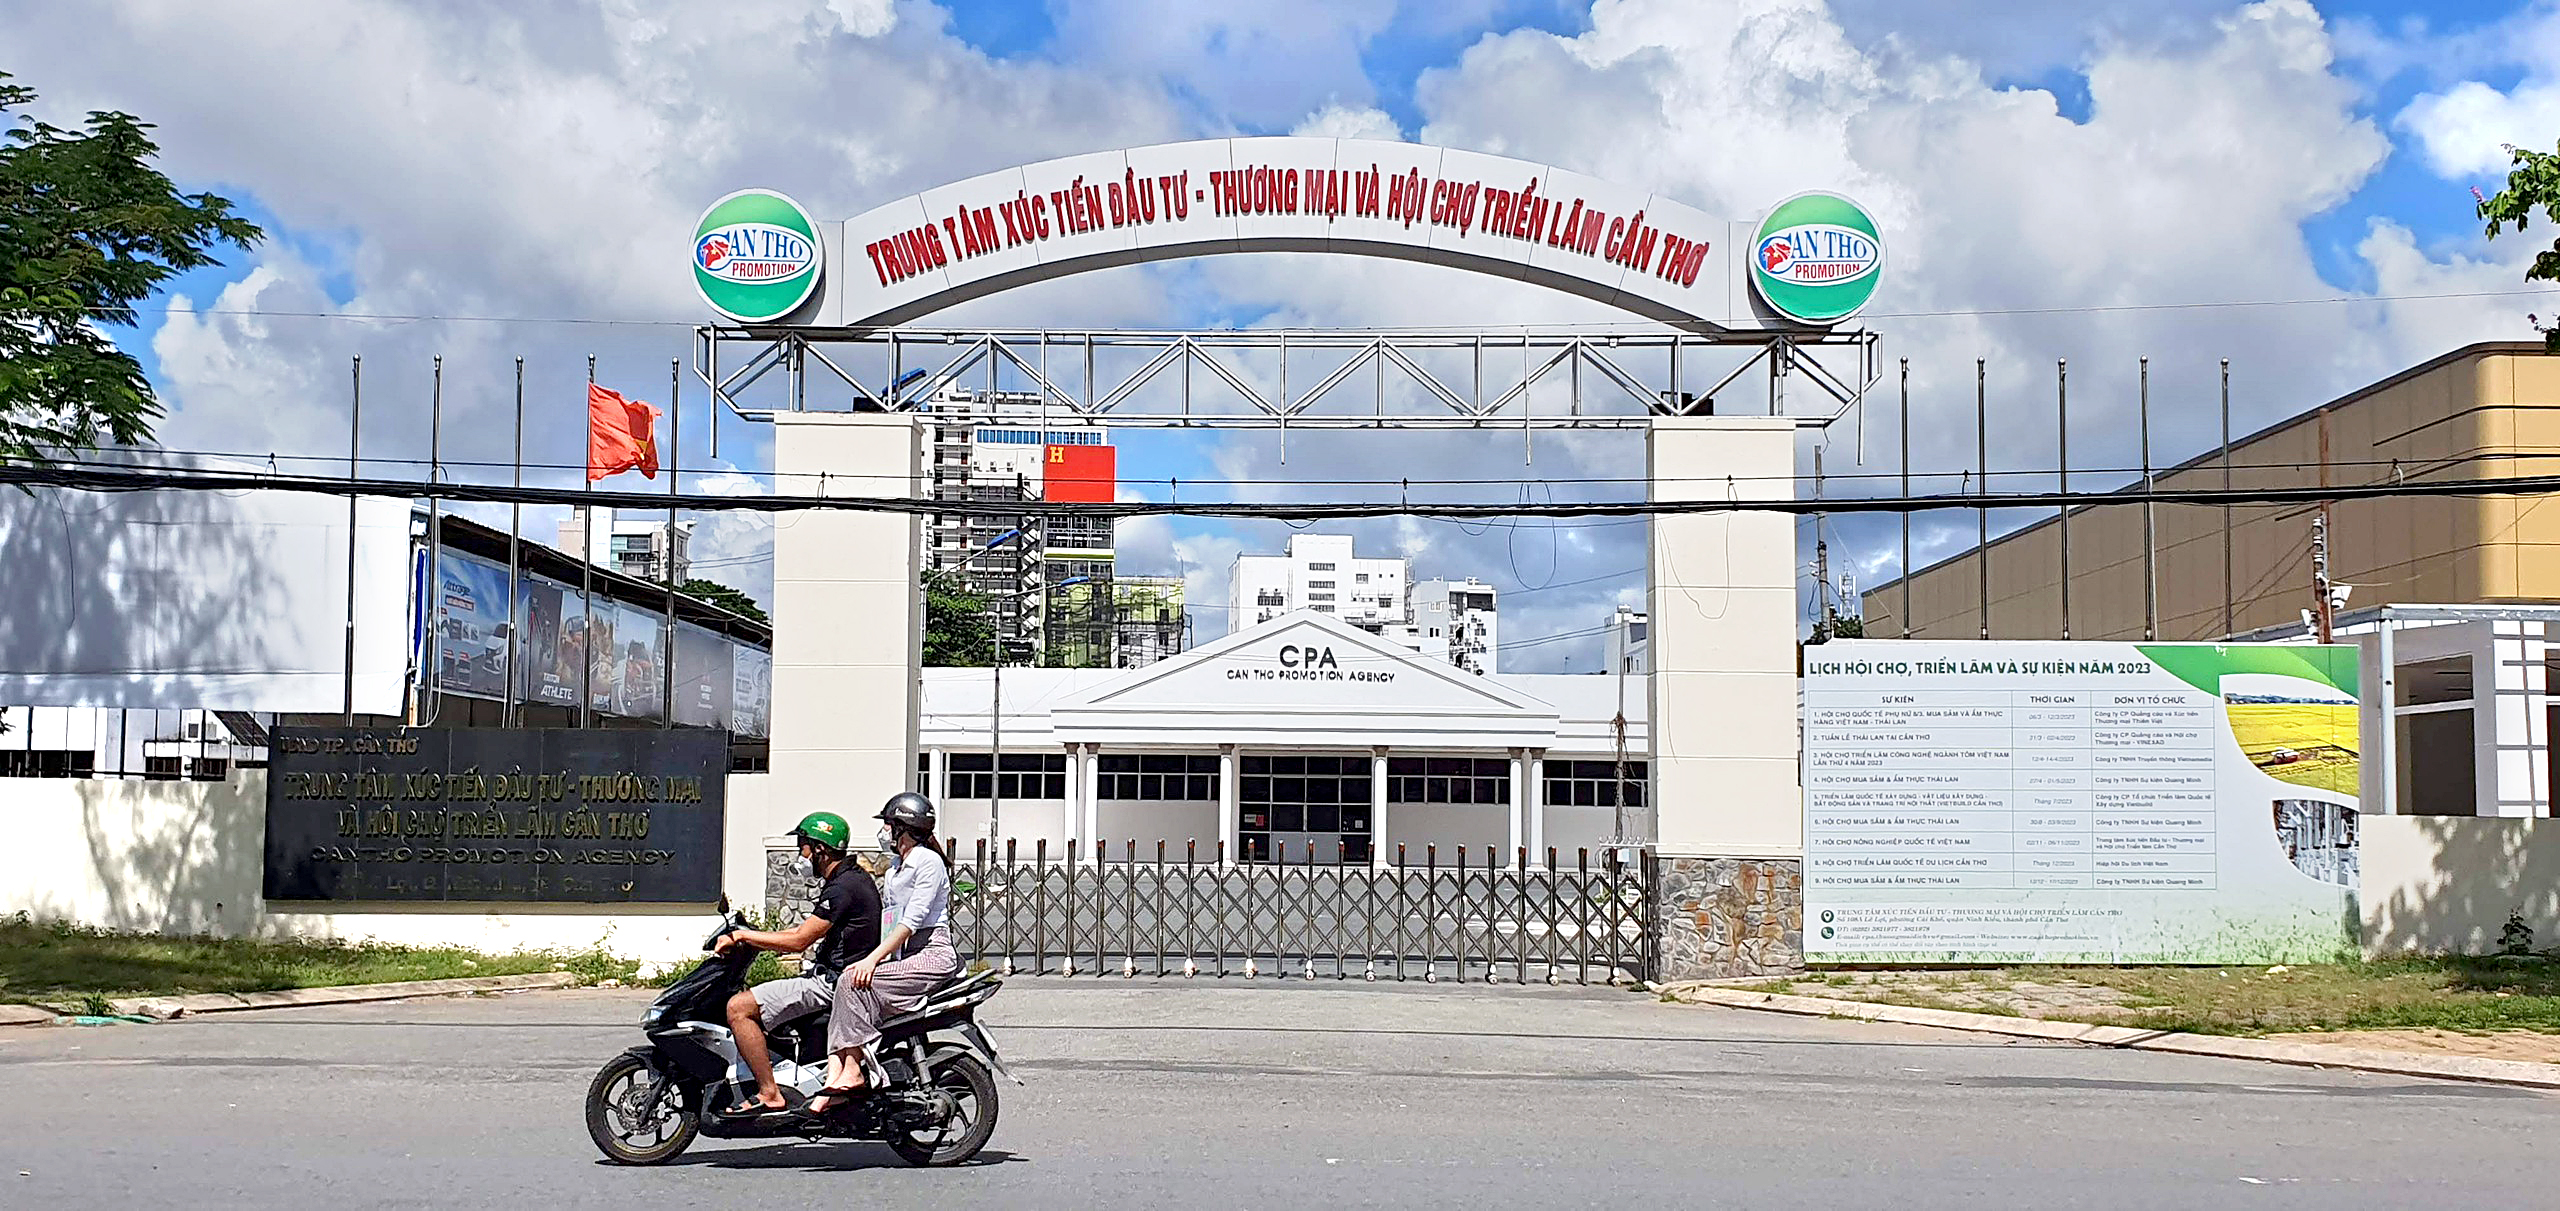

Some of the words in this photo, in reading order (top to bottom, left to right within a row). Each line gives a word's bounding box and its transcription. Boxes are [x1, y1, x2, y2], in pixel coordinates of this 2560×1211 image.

[866, 223, 948, 287] TRUNG
[943, 205, 1001, 261] TÂM
[998, 188, 1050, 246] XÚC
[1050, 176, 1105, 235] TIẾN
[1108, 166, 1156, 226] ĐẦU
[1160, 170, 1189, 222] TƯ
[1209, 165, 1299, 215] THƯƠNG
[1304, 169, 1349, 222] MẠI
[1355, 163, 1380, 216] VÀ
[1387, 167, 1428, 228] HỘI
[1430, 180, 1480, 237] CHỢ
[1482, 177, 1550, 242] TRIỂN
[1548, 199, 1606, 256] LÃM
[1605, 210, 1659, 272] CẦN
[1657, 233, 1710, 287] THƠ
[762, 230, 803, 258] THO
[1824, 231, 1867, 258] THO
[732, 262, 796, 277] PROMOTION
[1795, 264, 1860, 279] PROMOTION
[1049, 446, 1064, 463] H
[1279, 645, 1337, 669] CPA
[1810, 663, 1841, 678] LỊCH
[1845, 659, 1872, 678] HỘI
[1877, 663, 1912, 677] CHỢ,
[1916, 656, 1957, 674] TRIỂN
[1961, 659, 1994, 674] LÃM
[1997, 659, 2019, 674] VÀ
[2022, 662, 2039, 677] SỰ
[2042, 659, 2075, 677] KIỆN
[2080, 660, 2115, 675] NĂM
[2118, 663, 2151, 675] 2023
[1227, 669, 1248, 680] CAN
[1254, 669, 1274, 680] THO
[1279, 670, 1343, 681] PROMOTION
[1349, 671, 1395, 683] AGENCY
[541, 684, 573, 700] ATHLETE
[284, 772, 349, 800] TRUNG
[354, 766, 396, 800] TÂM
[402, 766, 441, 801] XÚC
[445, 765, 488, 801] TIẾN
[494, 764, 535, 801] ĐẦU
[537, 769, 567, 801] TƯ
[579, 770, 660, 803] THƯƠNG
[366, 804, 400, 841] HỘI
[404, 807, 447, 842] CHỢ
[450, 800, 507, 839] TRIỂN
[514, 804, 556, 839] LÃM
[561, 803, 600, 840] CẦN
[608, 809, 650, 840] THƠ
[418, 847, 566, 864] PROMOTION
[574, 849, 676, 866] AGENCY
